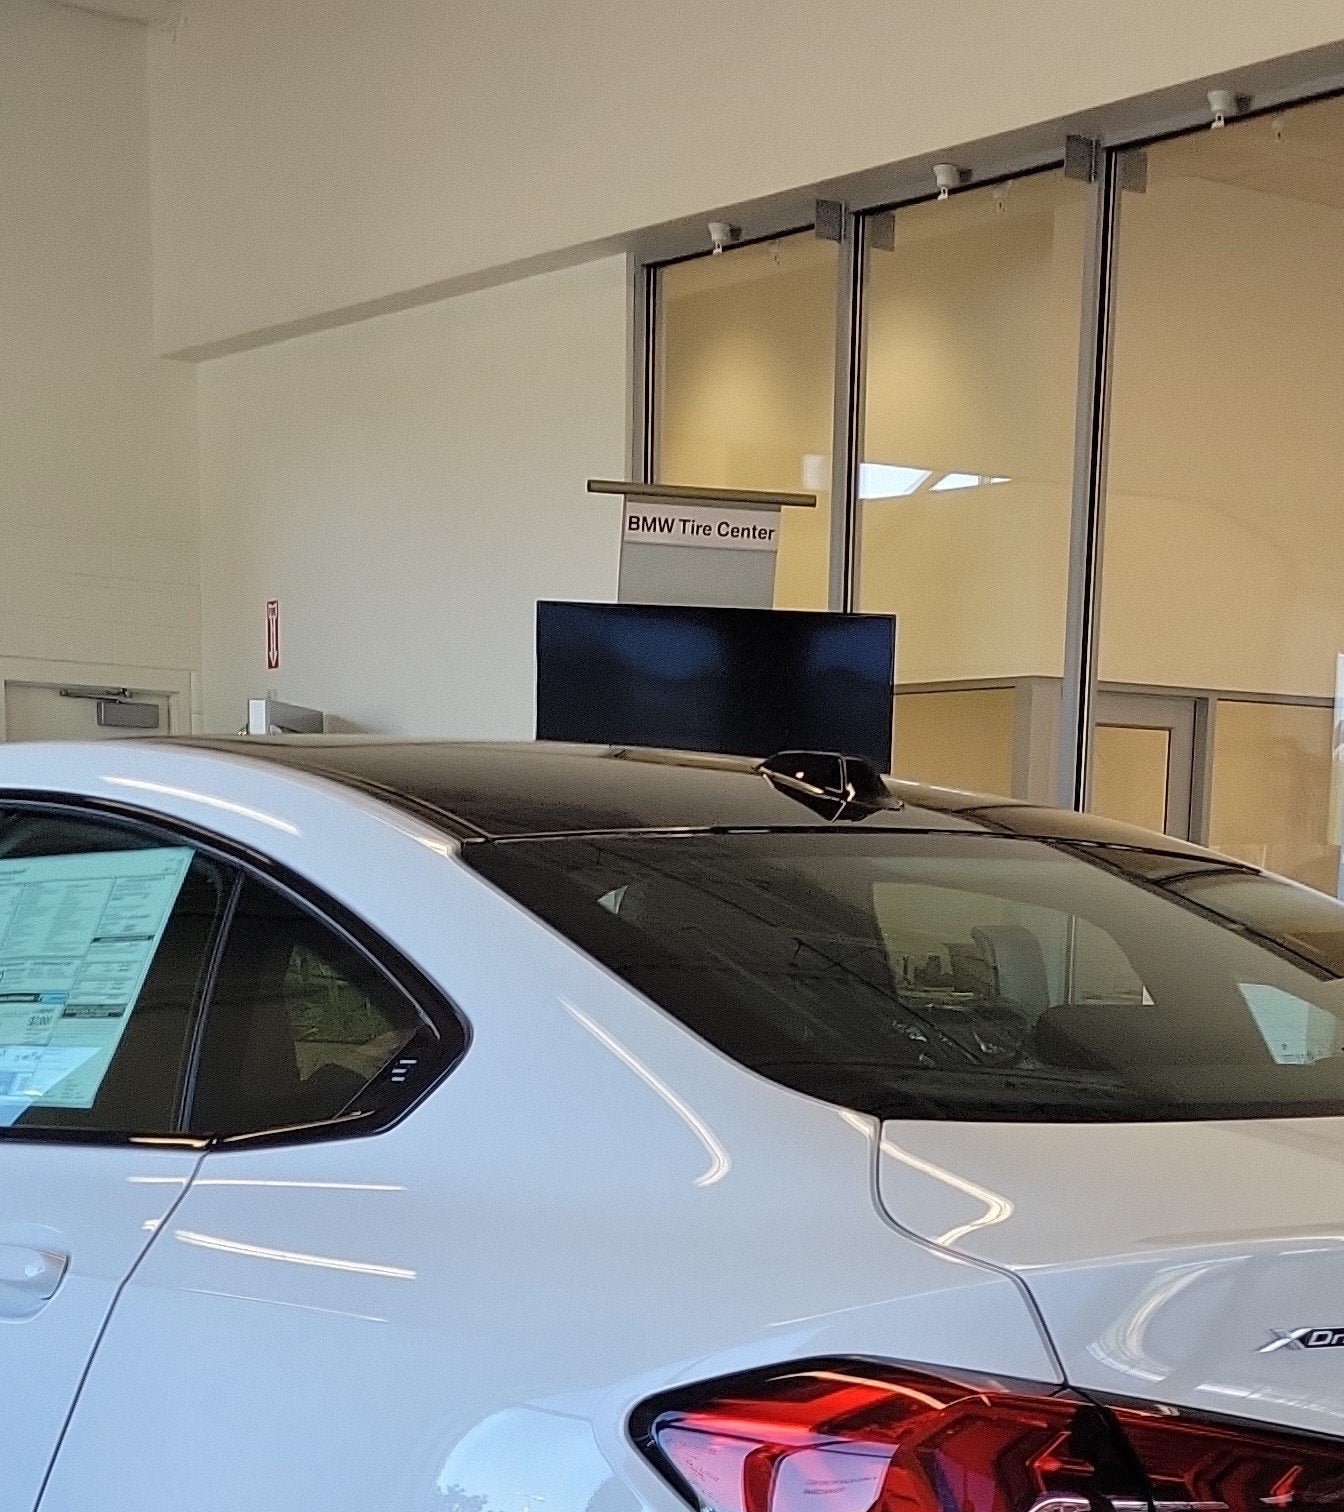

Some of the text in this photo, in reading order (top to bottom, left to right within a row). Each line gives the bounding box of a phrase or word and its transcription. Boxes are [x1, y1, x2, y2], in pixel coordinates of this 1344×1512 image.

[628, 515, 775, 541] BMW Tire Center
